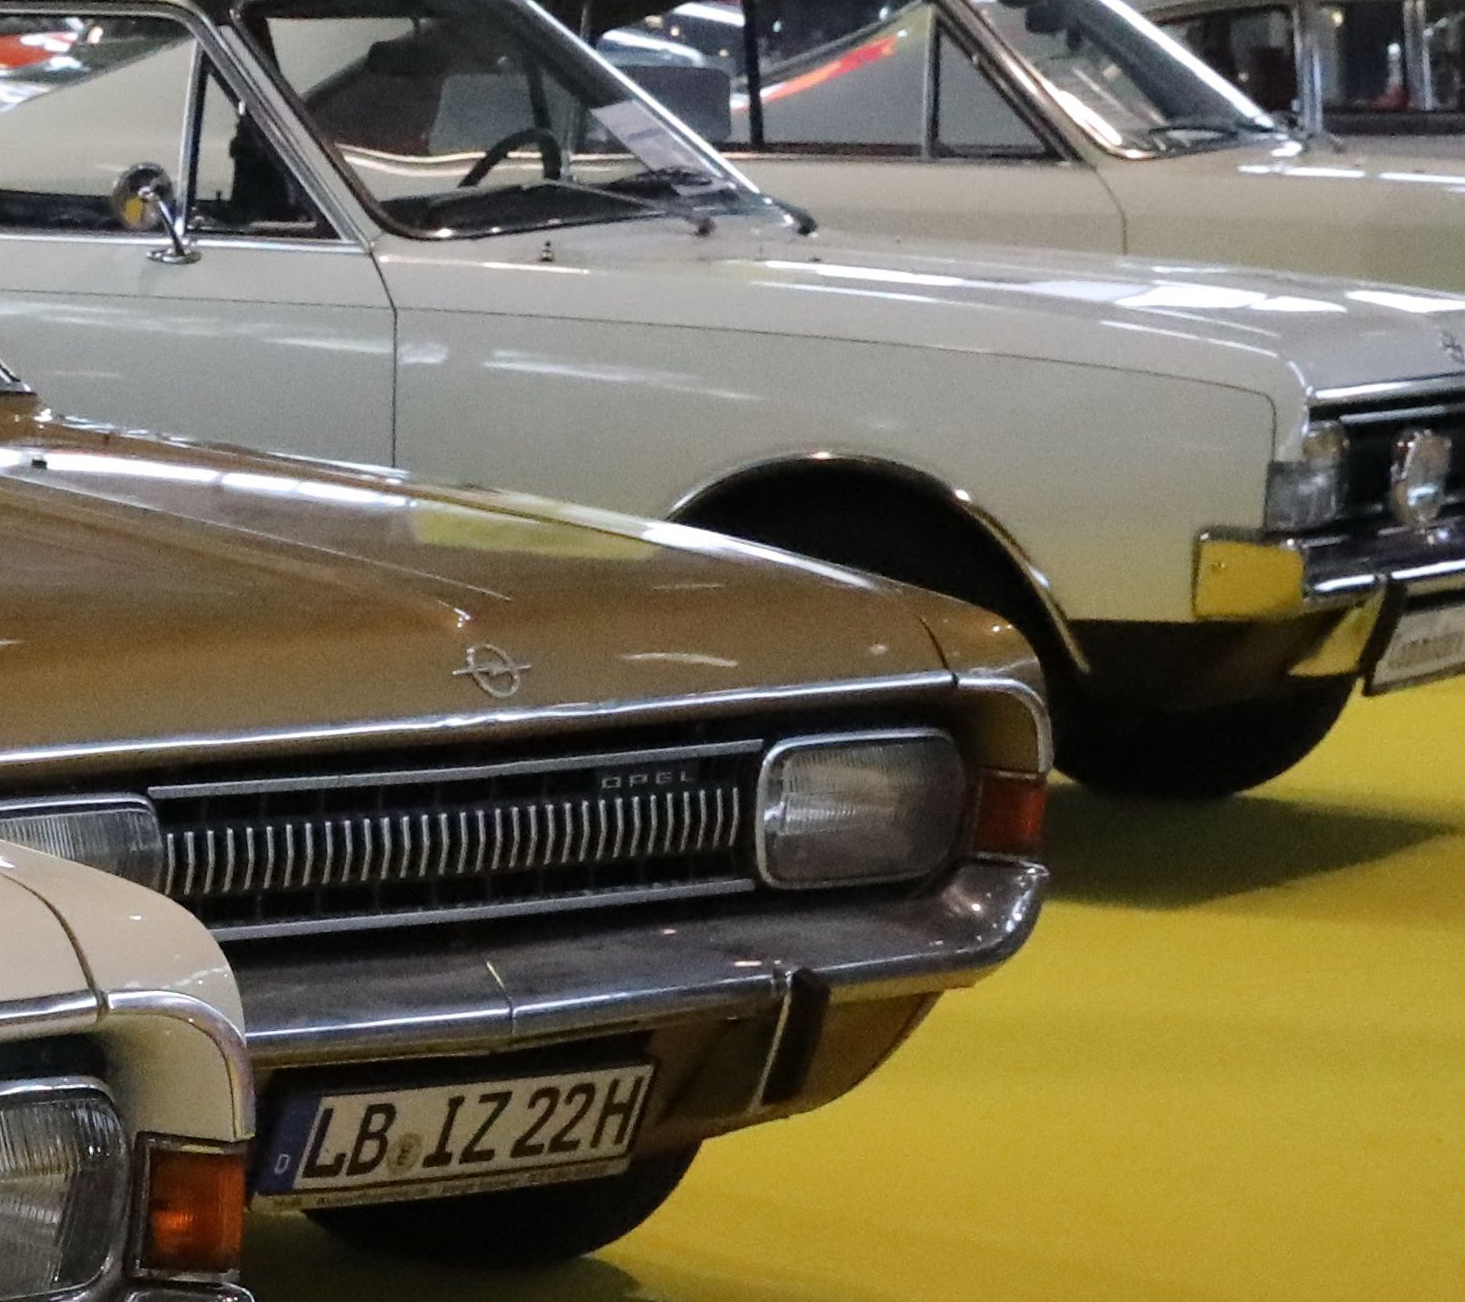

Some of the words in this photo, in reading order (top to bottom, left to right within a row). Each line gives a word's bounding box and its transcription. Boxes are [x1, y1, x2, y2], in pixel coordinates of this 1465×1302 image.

[601, 770, 696, 789] OPEL
[301, 1102, 397, 1178] LB
[421, 1090, 513, 1169] IZ
[510, 1074, 645, 1159] 22H
[273, 1152, 290, 1175] D
